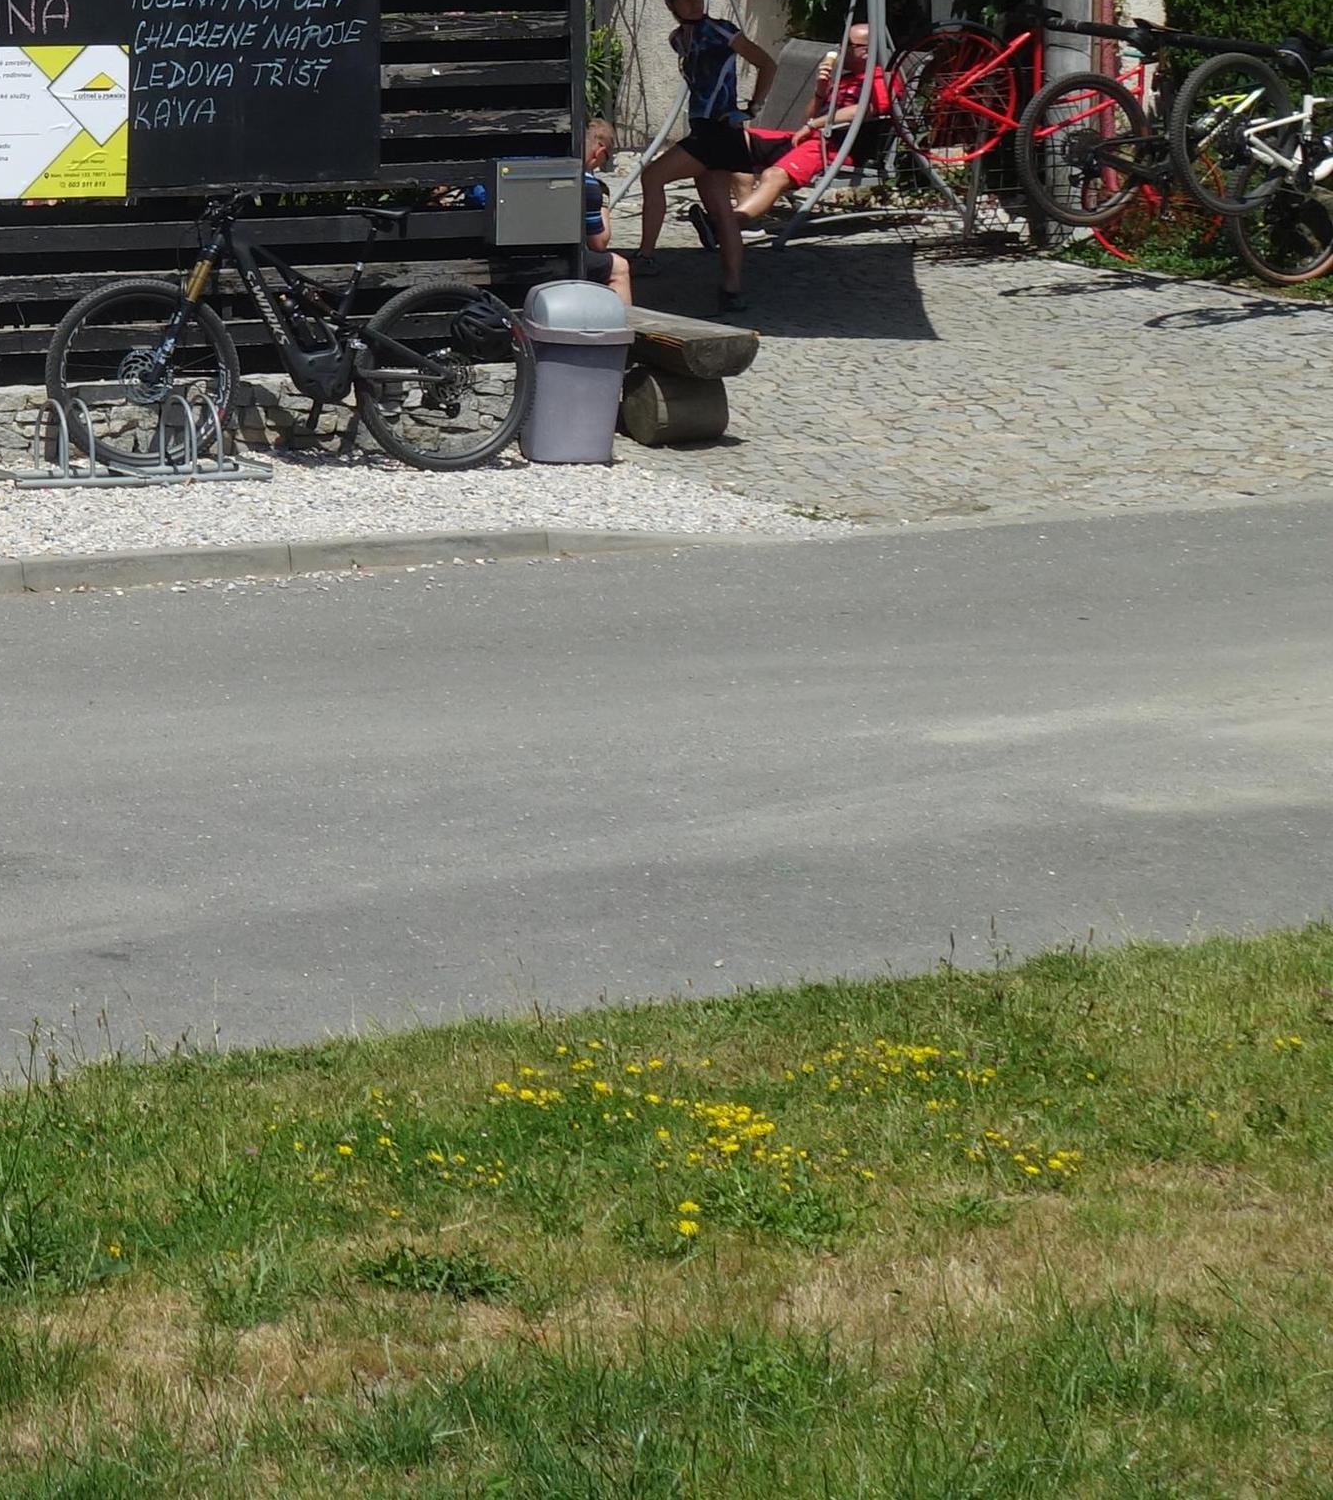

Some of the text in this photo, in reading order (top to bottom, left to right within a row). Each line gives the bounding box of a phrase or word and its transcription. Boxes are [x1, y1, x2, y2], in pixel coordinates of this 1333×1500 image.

[134, 15, 368, 54] CHLAZENÉ NÁPOJE
[133, 55, 244, 91] LEDOVÁ
[134, 96, 217, 130] KÁVA
